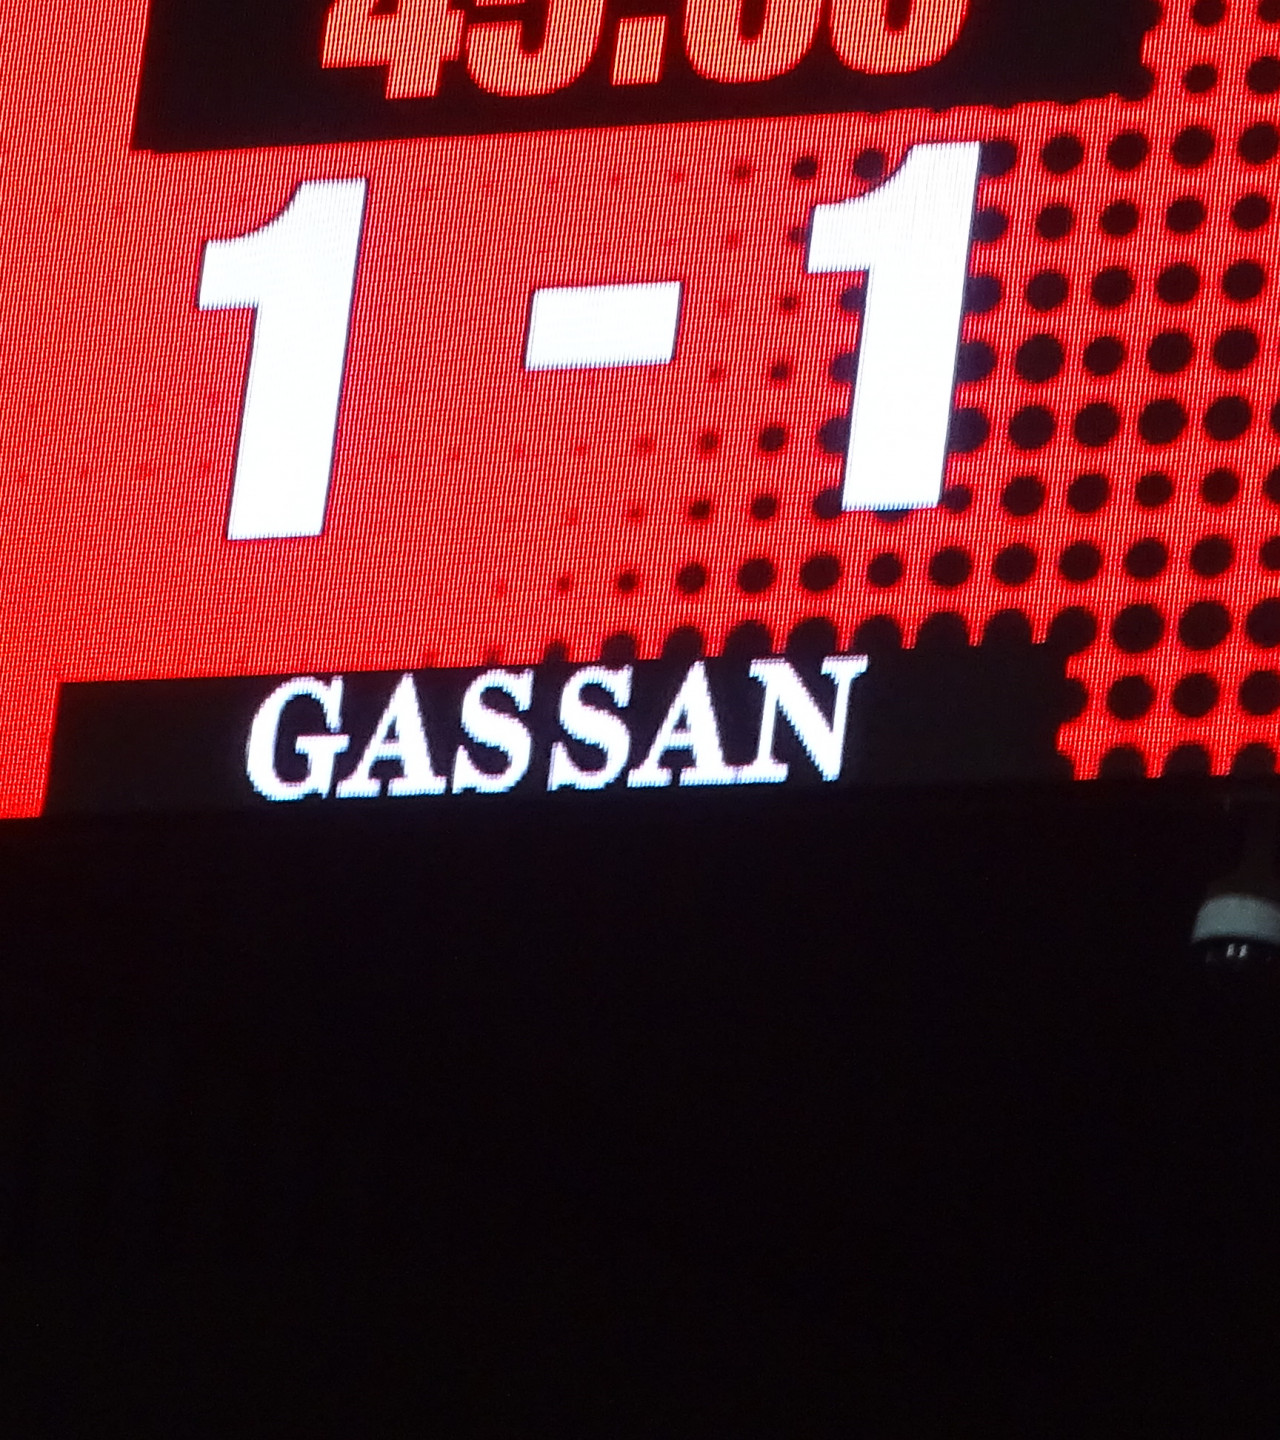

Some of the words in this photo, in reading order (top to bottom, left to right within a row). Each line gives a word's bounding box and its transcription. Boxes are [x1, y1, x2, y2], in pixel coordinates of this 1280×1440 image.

[198, 177, 368, 542] 1
[806, 140, 981, 512] 1
[245, 654, 869, 801] GASSAN
